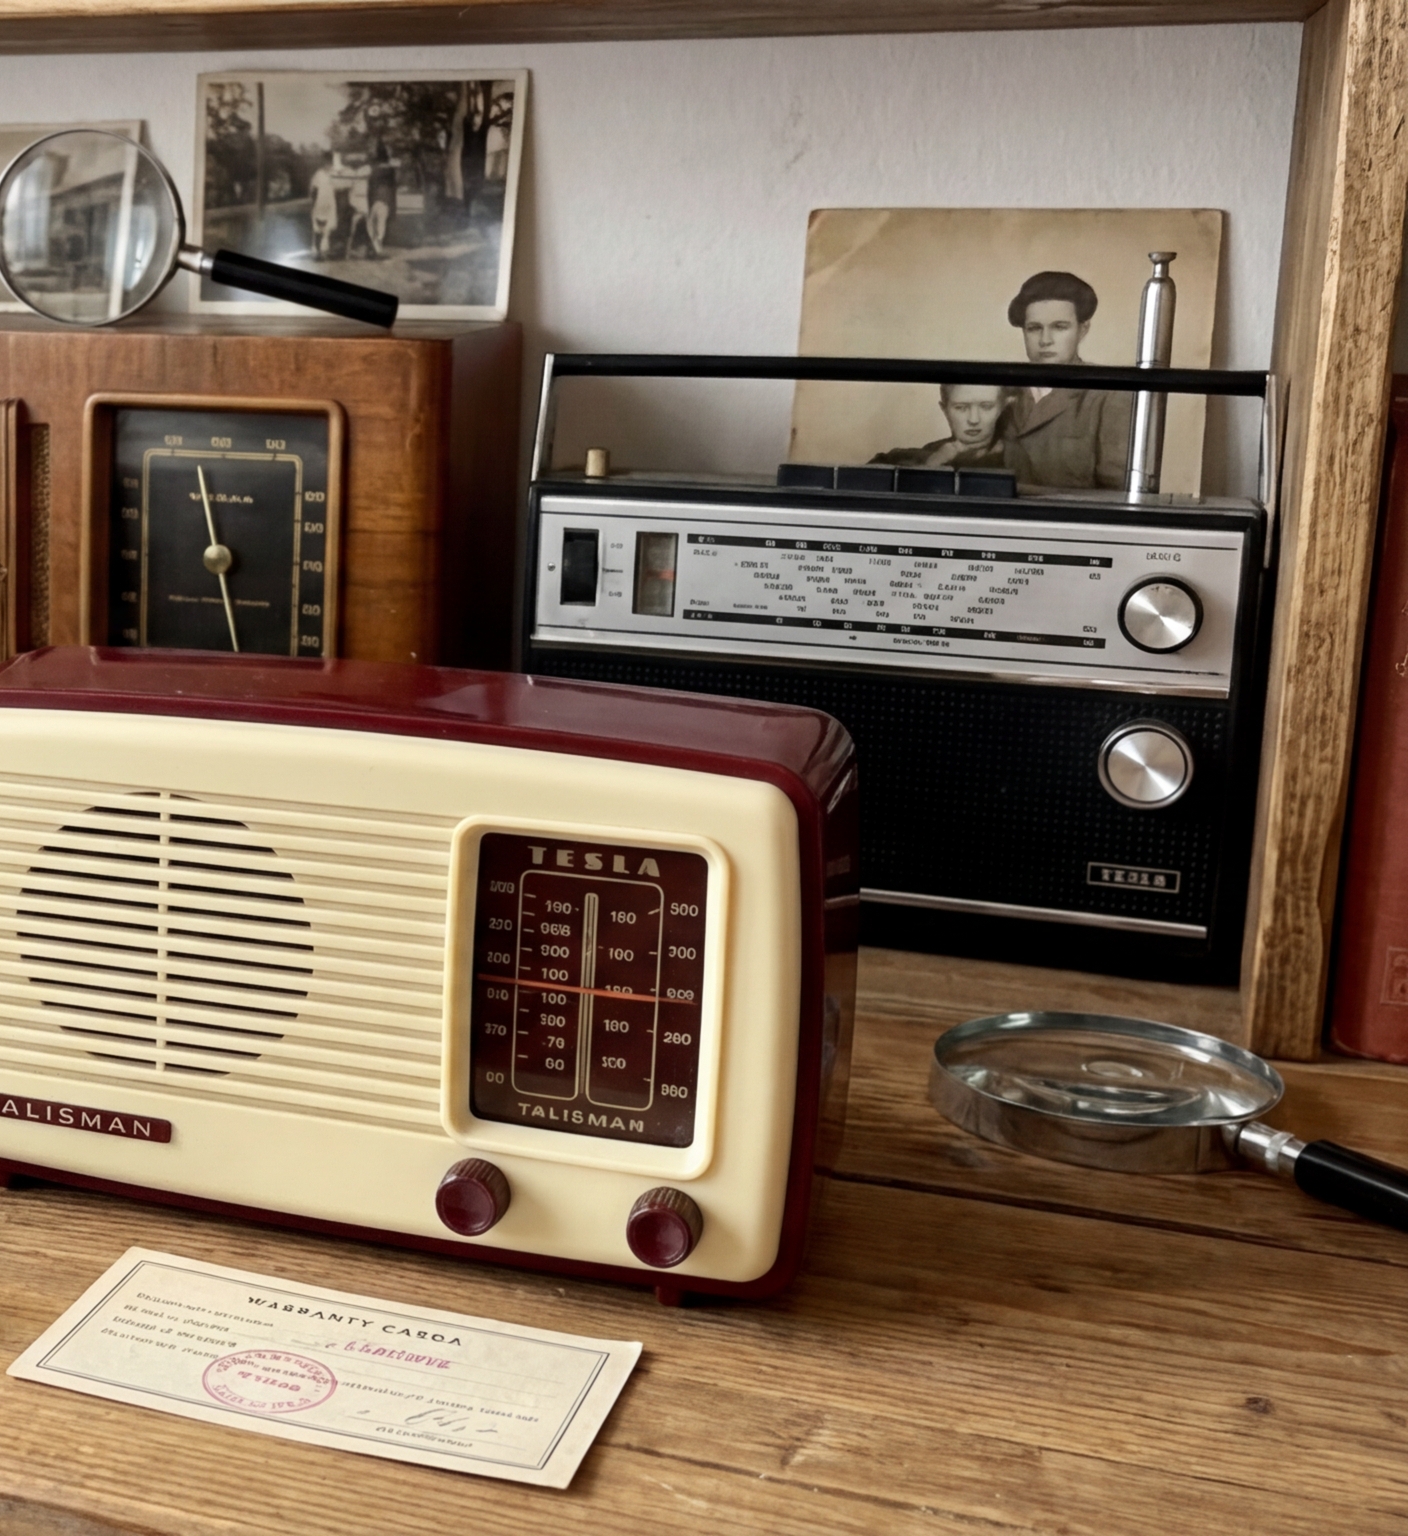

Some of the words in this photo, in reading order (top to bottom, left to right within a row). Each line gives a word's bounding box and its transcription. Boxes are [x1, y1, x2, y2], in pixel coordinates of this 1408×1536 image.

[527, 845, 660, 878] TESLA
[541, 967, 569, 982] 100
[518, 1102, 644, 1133] TALISMAN
